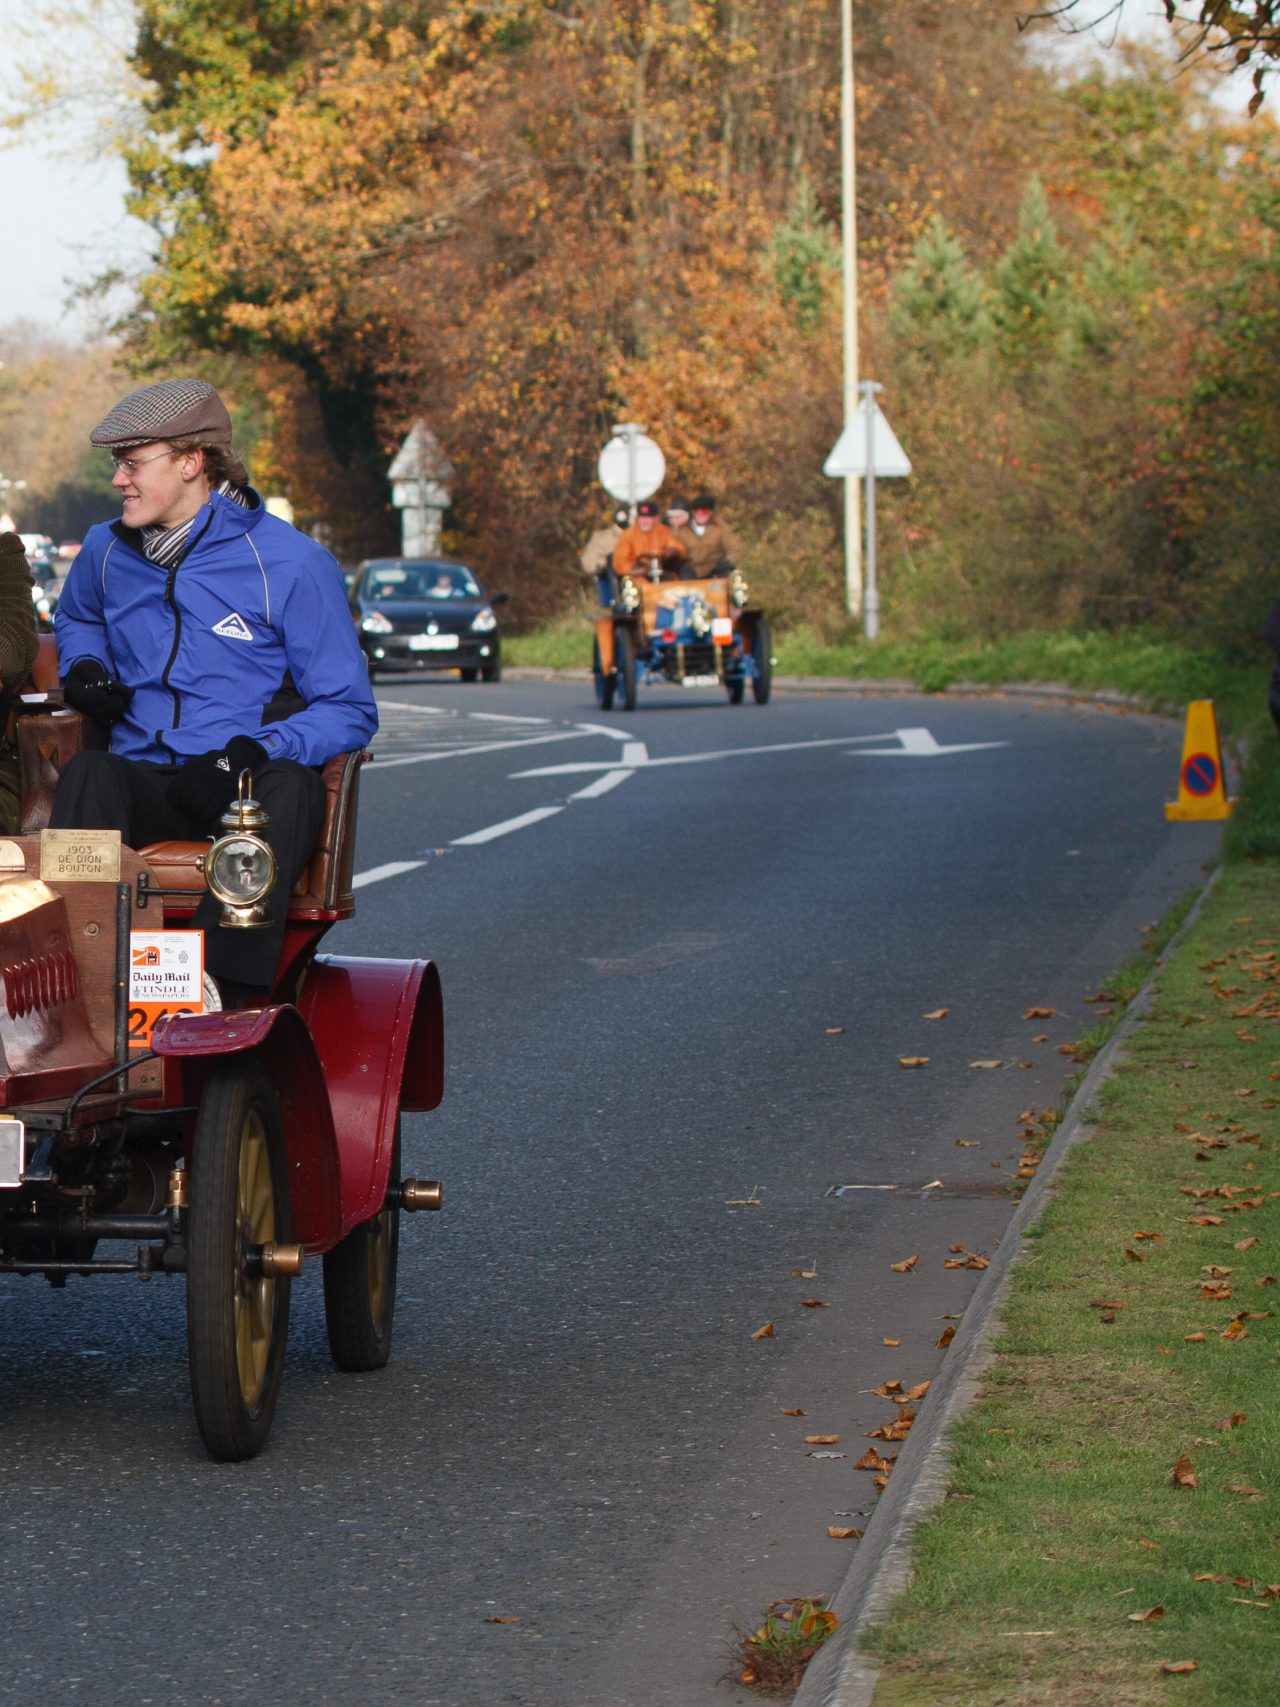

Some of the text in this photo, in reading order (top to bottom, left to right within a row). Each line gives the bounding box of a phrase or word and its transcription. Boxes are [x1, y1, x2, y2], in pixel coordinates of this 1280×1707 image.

[68, 845, 93, 854] 1903
[58, 855, 102, 863] DE DION
[58, 864, 101, 873] BOUTON
[133, 972, 190, 984] Daily Mail
